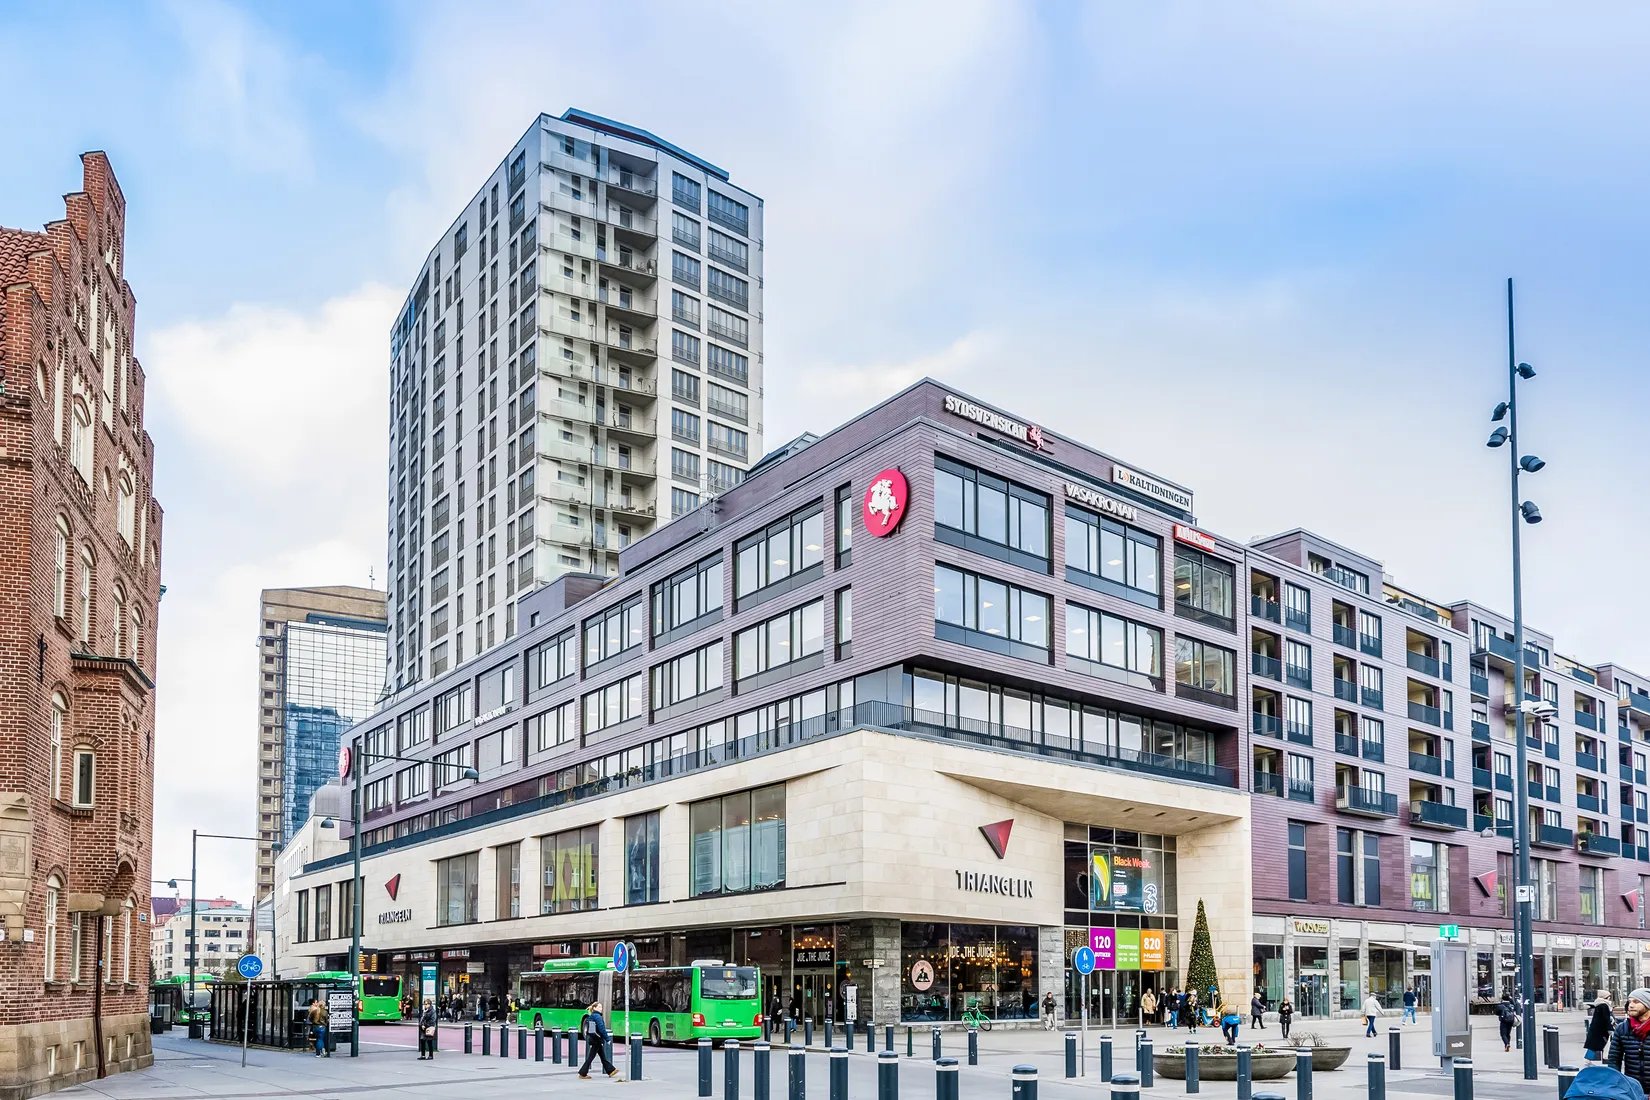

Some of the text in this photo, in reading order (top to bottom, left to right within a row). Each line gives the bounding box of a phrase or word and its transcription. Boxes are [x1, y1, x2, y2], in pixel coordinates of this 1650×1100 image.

[945, 394, 1027, 441] SYDSVENSKAN
[1064, 482, 1137, 520] VASAKRONAN
[1113, 855, 1132, 867] Black
[954, 869, 1033, 899] TRIANGELN
[1094, 935, 1111, 949] 120
[1143, 937, 1161, 950] 820
[963, 946, 976, 957] THE
